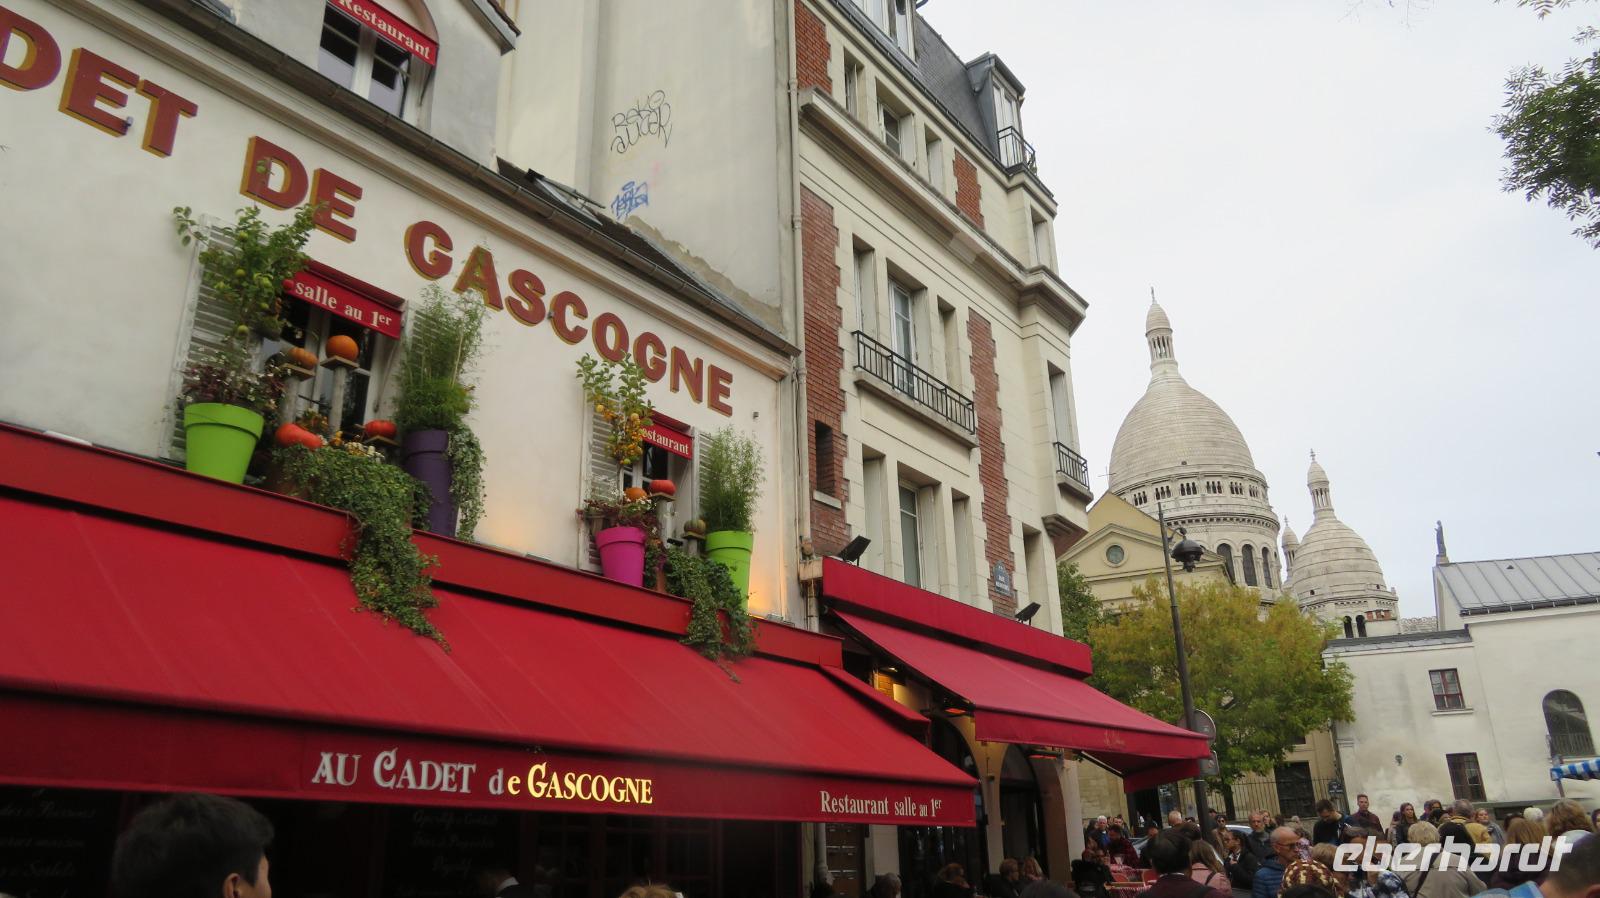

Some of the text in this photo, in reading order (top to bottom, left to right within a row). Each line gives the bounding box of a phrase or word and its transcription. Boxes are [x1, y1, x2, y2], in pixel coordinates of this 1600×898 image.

[338, 0, 430, 59] Restaurant
[239, 135, 363, 244] DE
[404, 220, 733, 418] GASCOGNE
[295, 282, 337, 309] salle
[344, 304, 362, 321] au
[639, 428, 689, 455] estaurant
[311, 747, 653, 804] AU CADET de GASCOGNE
[820, 790, 889, 815] Restaurant
[894, 796, 917, 817] salle
[919, 803, 928, 817] au
